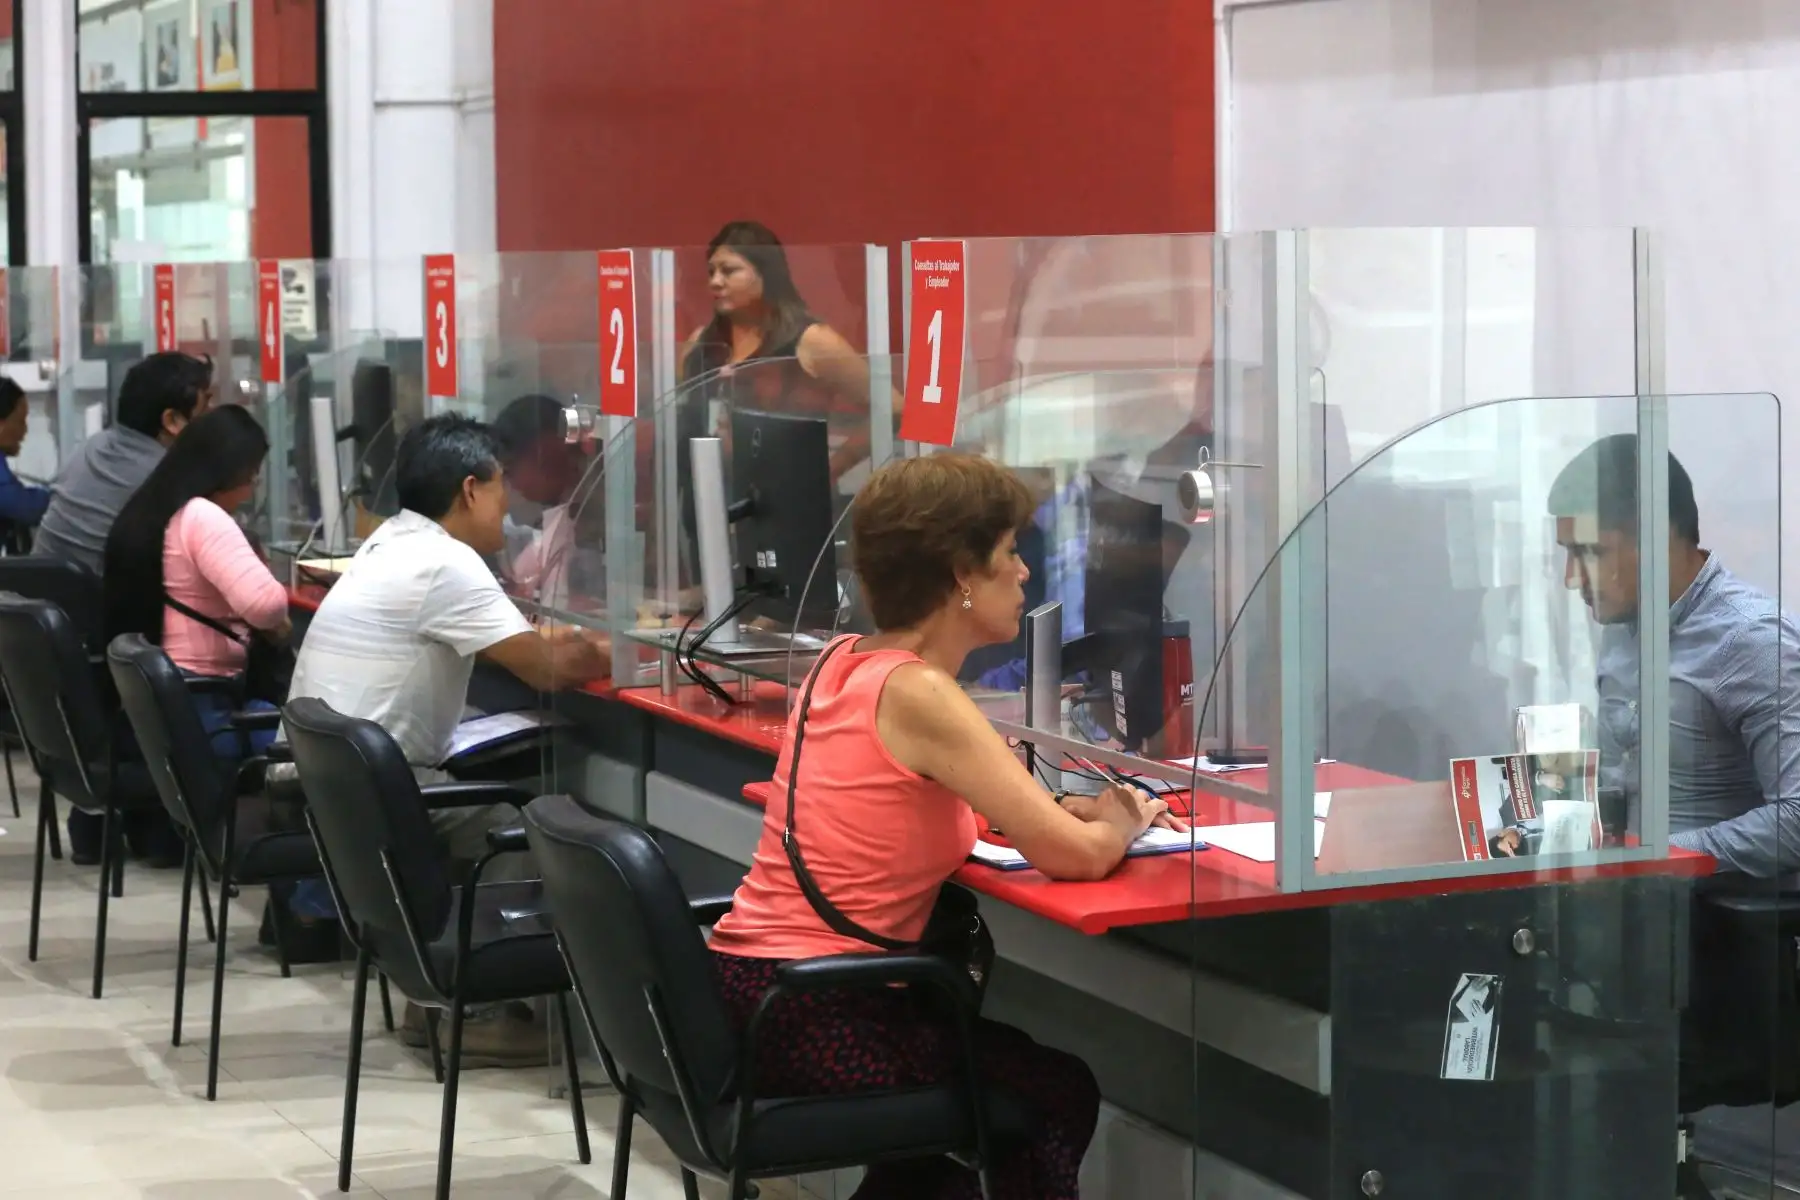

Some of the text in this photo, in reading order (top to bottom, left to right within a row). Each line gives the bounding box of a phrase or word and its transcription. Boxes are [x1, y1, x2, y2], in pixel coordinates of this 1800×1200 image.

[161, 299, 170, 353] 5
[265, 300, 276, 360] 4
[436, 300, 448, 369] 3
[609, 307, 625, 385] 2
[922, 309, 943, 404] 1
